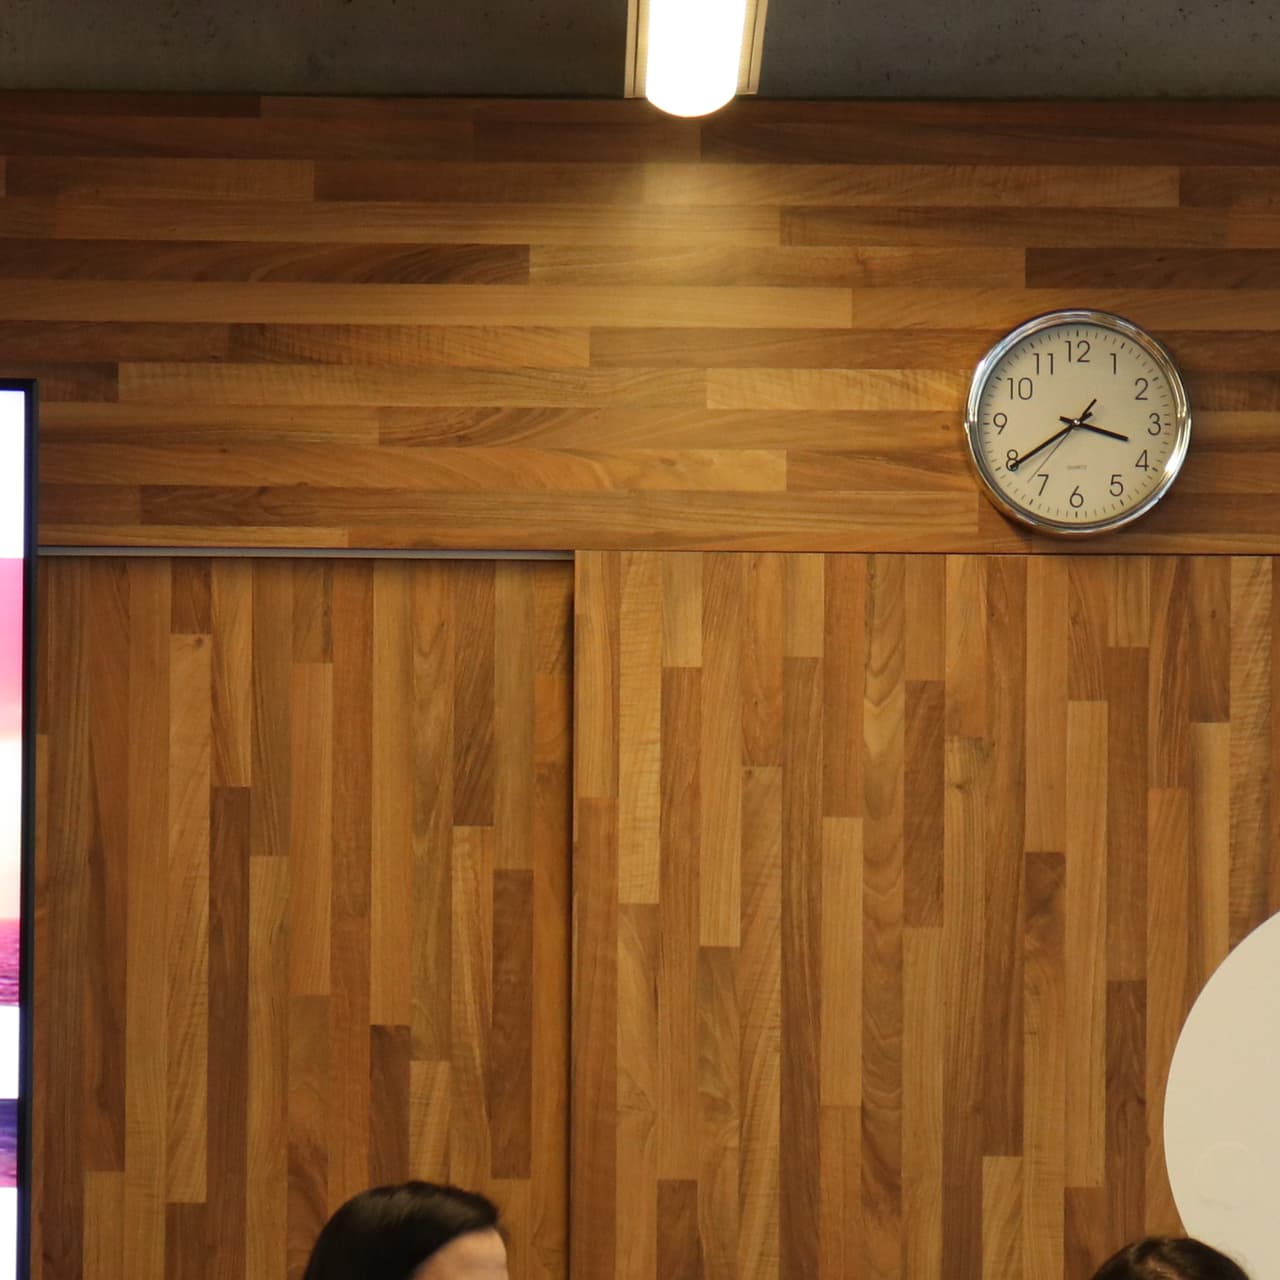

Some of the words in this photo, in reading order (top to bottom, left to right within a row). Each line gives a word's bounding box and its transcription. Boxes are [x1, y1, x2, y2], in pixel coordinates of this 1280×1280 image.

[1065, 340, 1091, 363] 12
[1033, 353, 1054, 375] 11
[1110, 353, 1117, 375] 1
[1007, 377, 1033, 400] 10
[1135, 378, 1148, 400] 2
[993, 413, 1008, 435] 9
[1147, 413, 1161, 436] 3
[1006, 449, 1019, 472] 8
[1135, 450, 1150, 471] 4
[1037, 474, 1049, 496] 7
[1109, 474, 1124, 497] 5
[1069, 485, 1084, 508] 6
